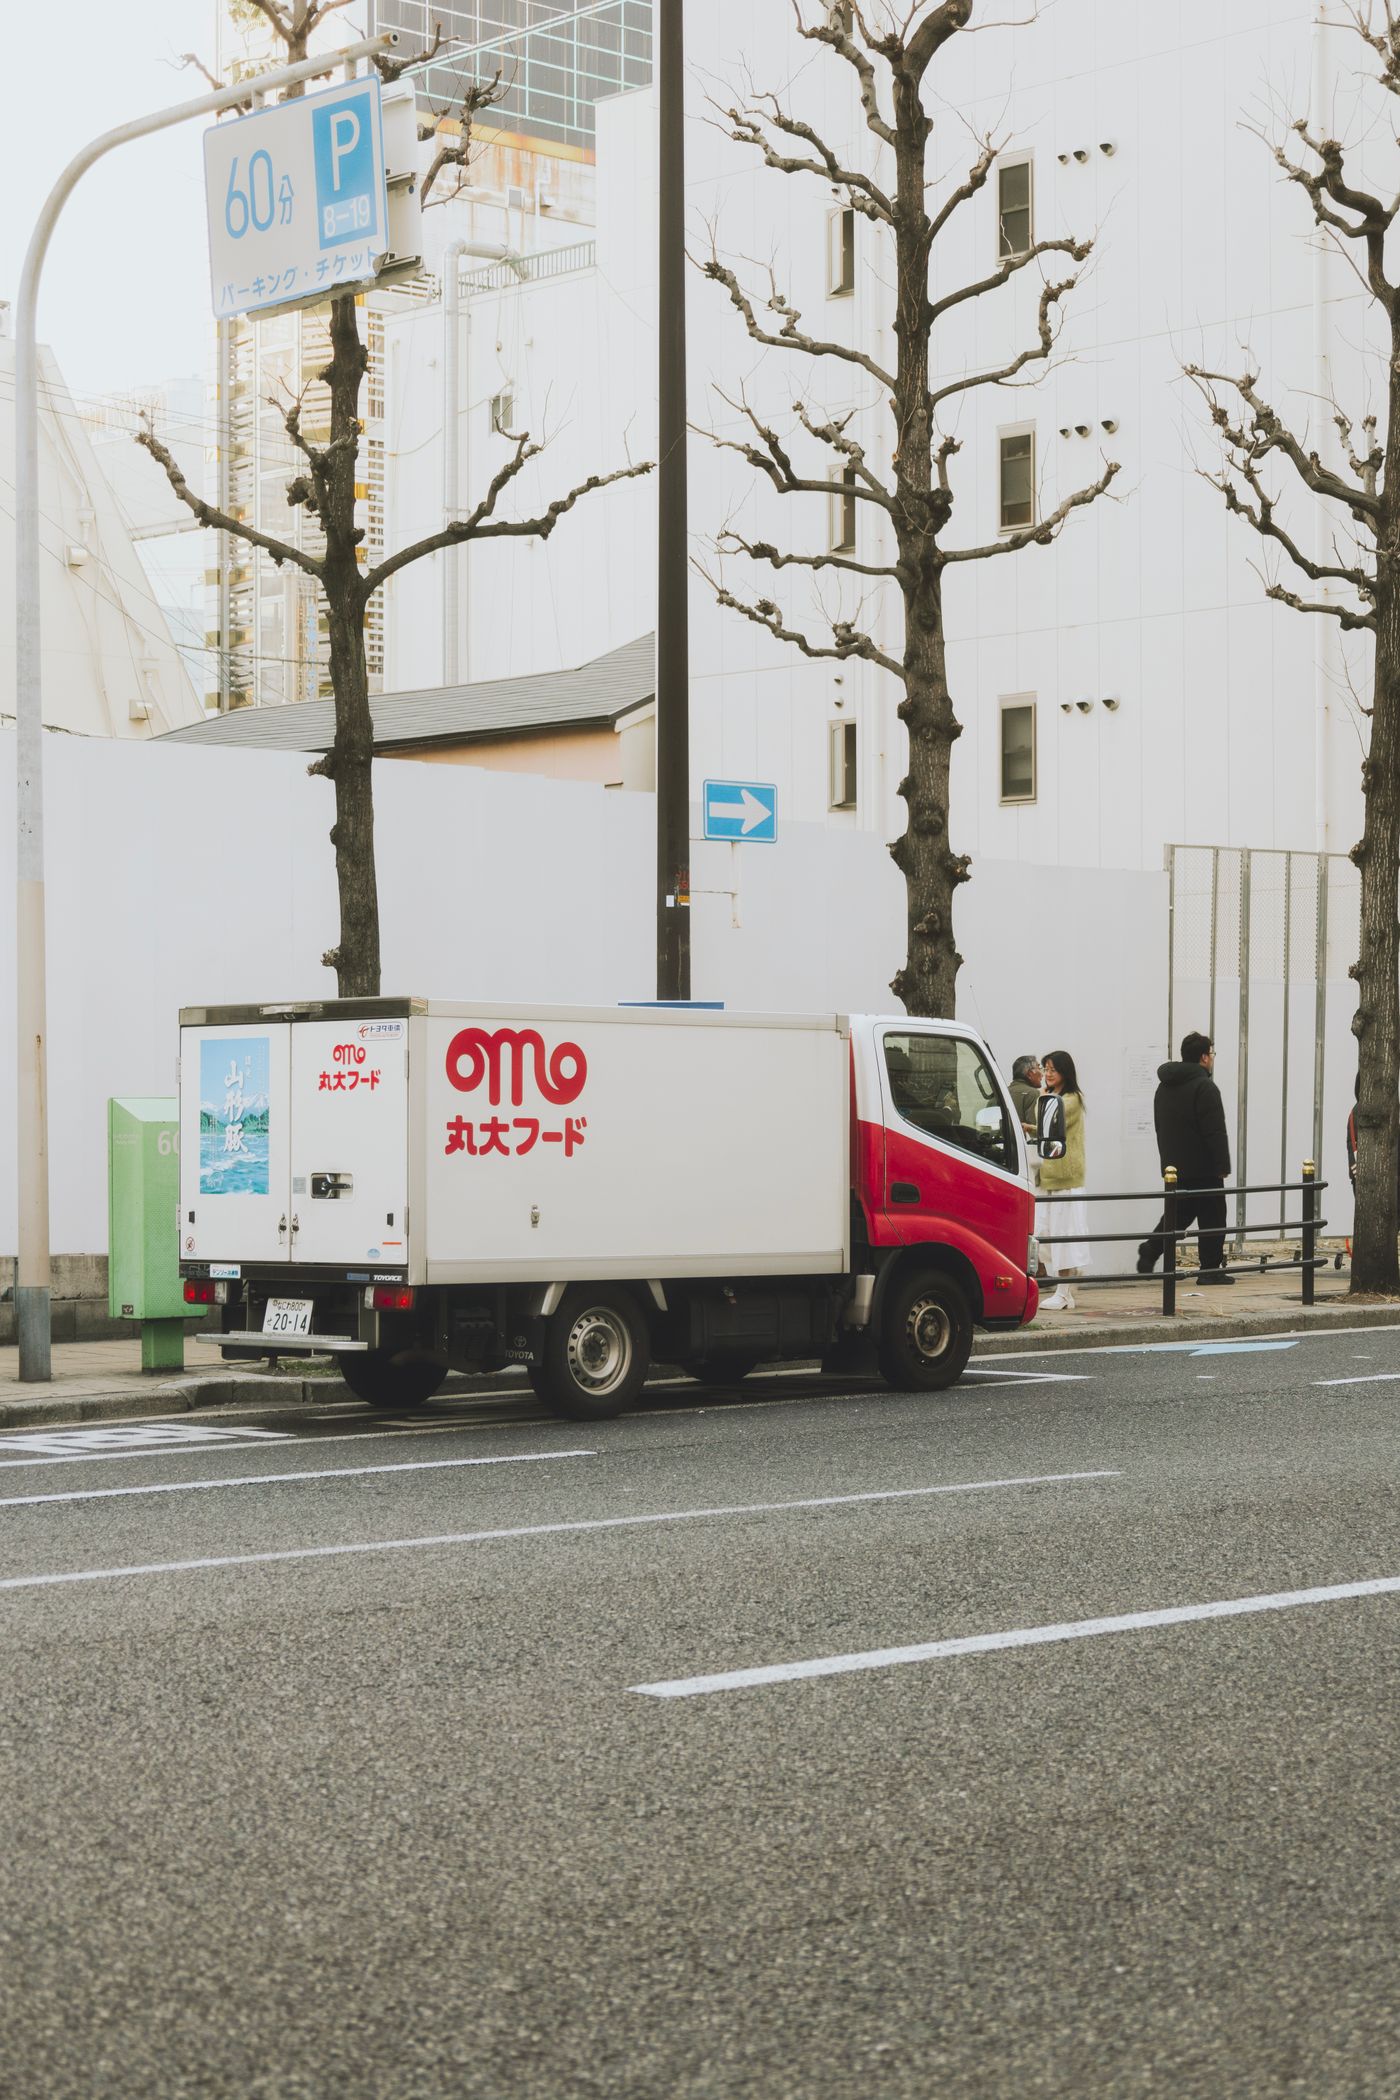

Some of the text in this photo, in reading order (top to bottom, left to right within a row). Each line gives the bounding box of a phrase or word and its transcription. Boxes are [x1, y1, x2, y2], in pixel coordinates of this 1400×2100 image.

[330, 109, 361, 192] P
[225, 149, 294, 239] 60分
[318, 1069, 382, 1091] 丸大フード
[445, 1115, 588, 1158] 丸大フード
[373, 1274, 403, 1282] TOYOACE
[272, 1313, 308, 1332] 20-14
[505, 1351, 534, 1360] TOYOTA
